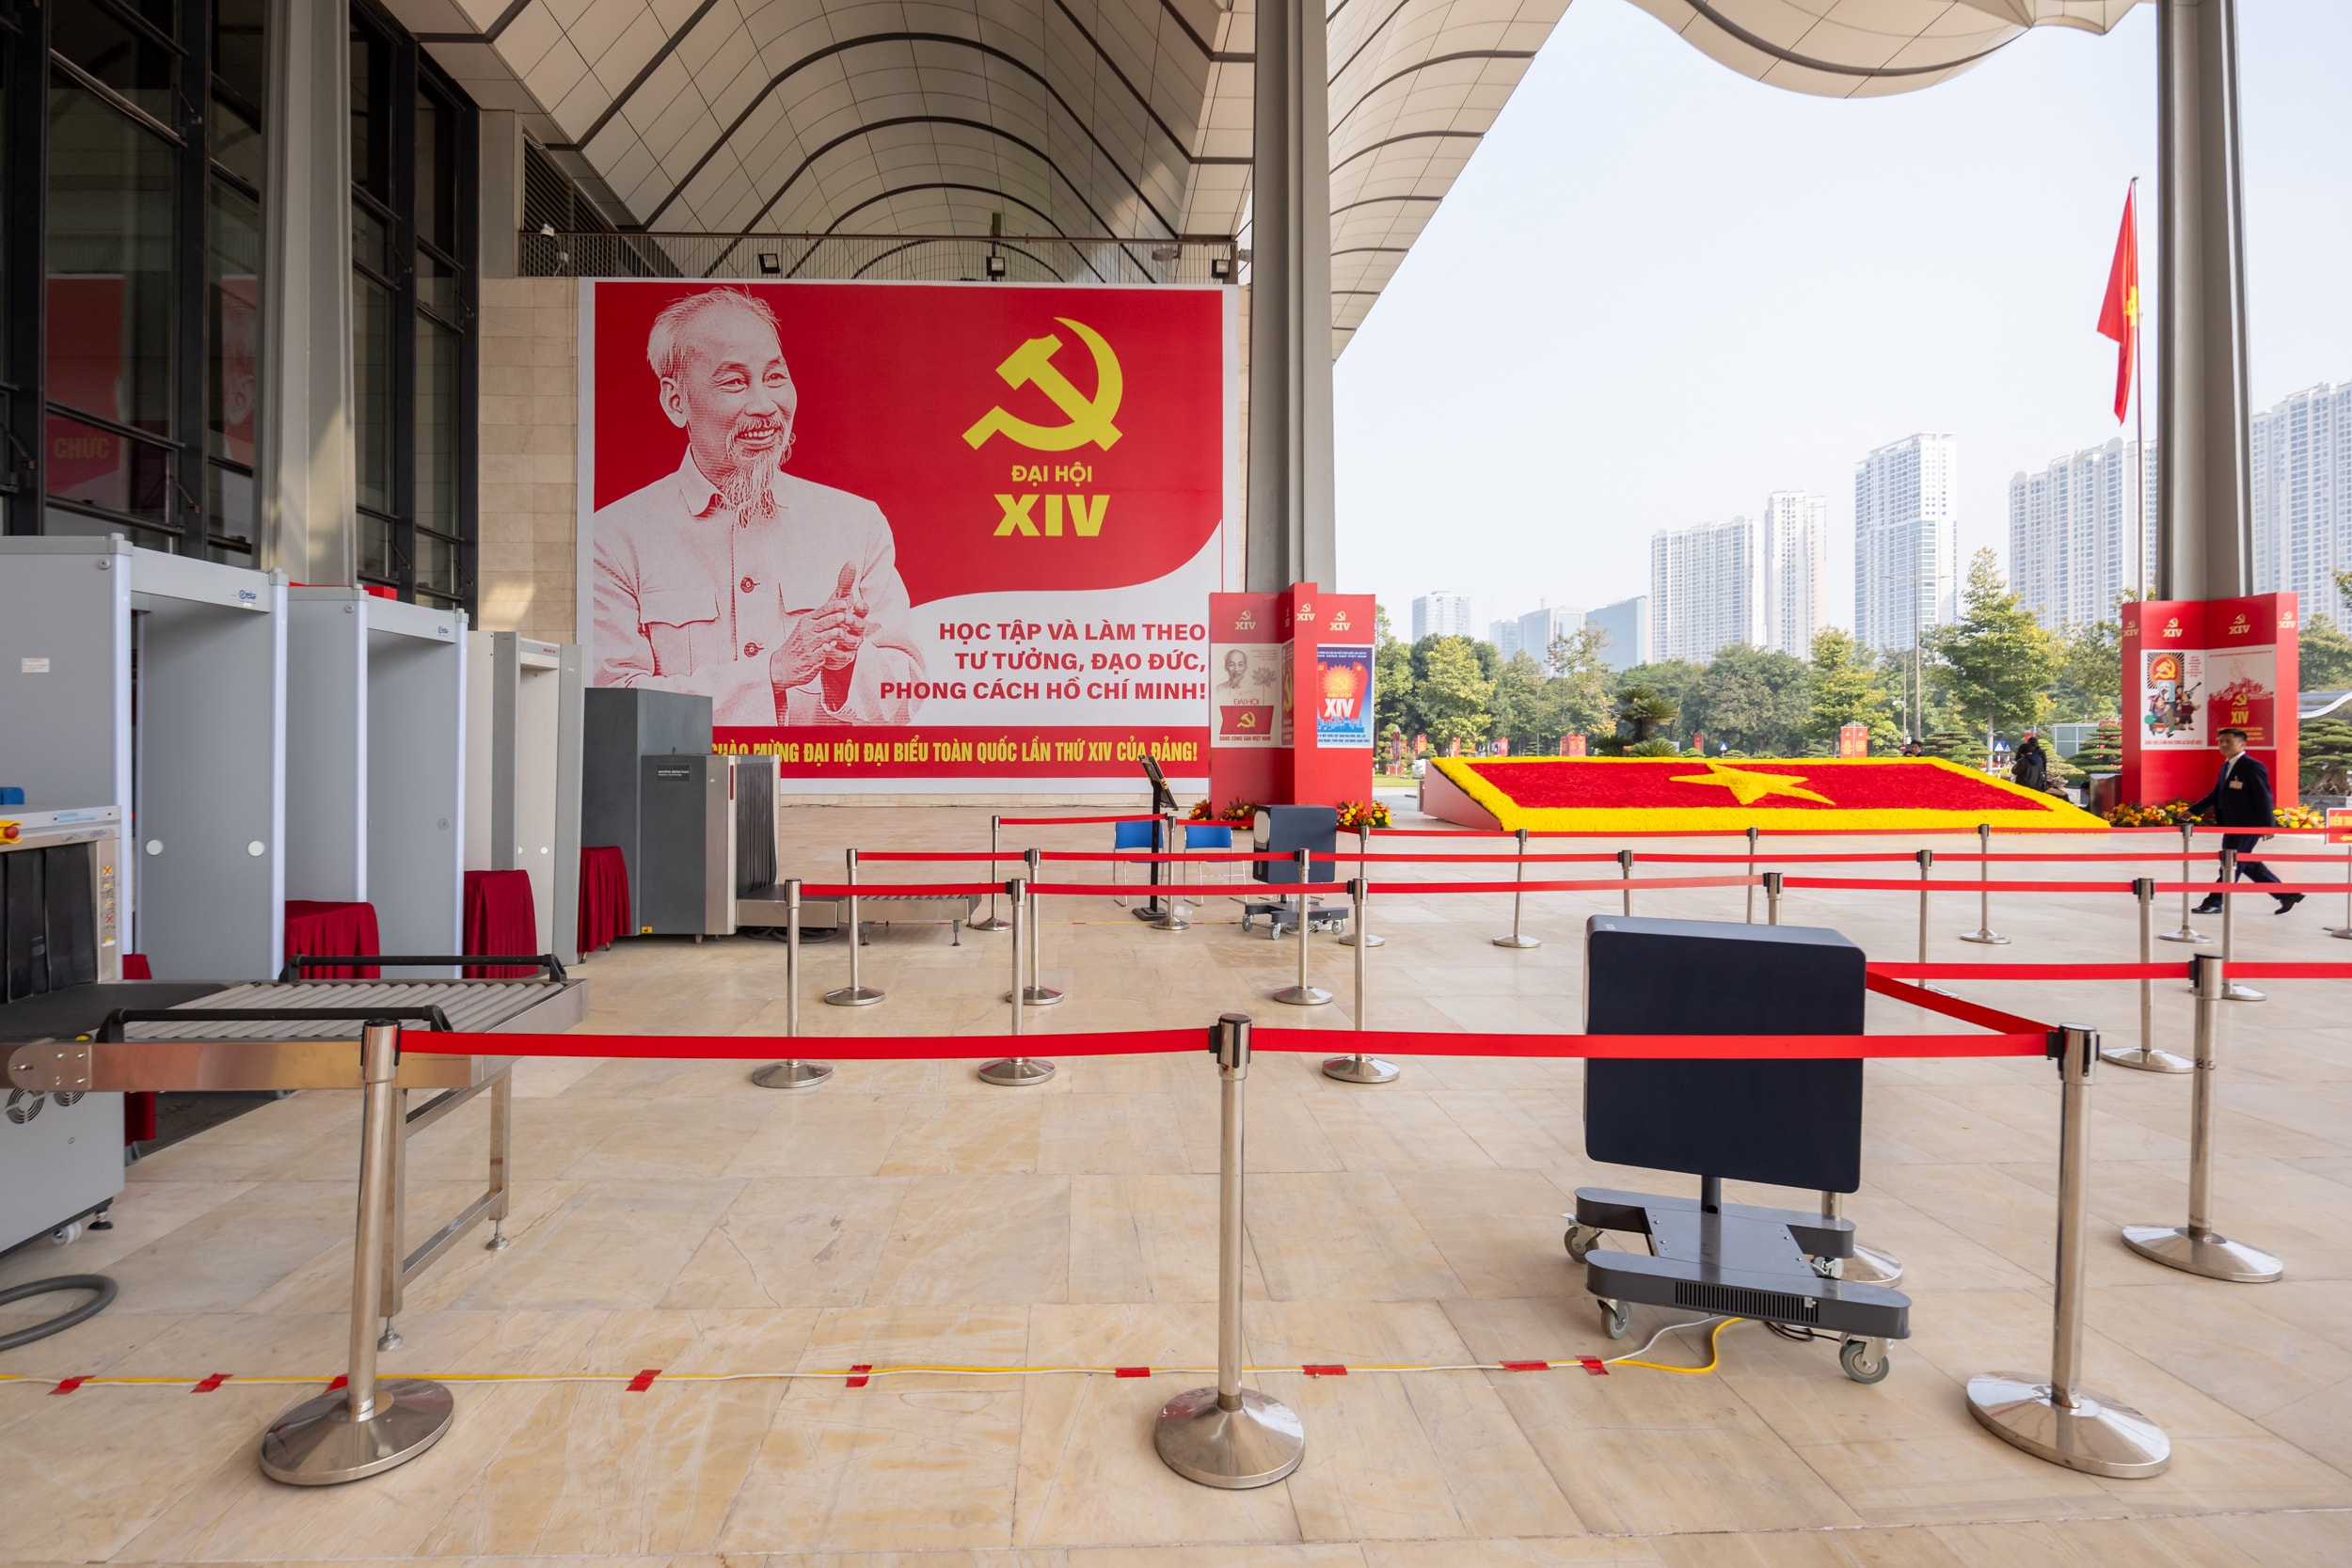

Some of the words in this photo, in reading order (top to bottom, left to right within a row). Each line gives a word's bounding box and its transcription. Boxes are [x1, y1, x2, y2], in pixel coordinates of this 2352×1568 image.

[1011, 465, 1048, 486] ĐẠI
[1055, 461, 1092, 487] HỘI
[993, 494, 1110, 537] XIV
[1235, 622, 1256, 630] XIV
[1296, 613, 1315, 622] XIV
[2278, 621, 2296, 629] XIV
[940, 623, 991, 645] HỌC
[997, 619, 1041, 645] TẬP
[1048, 619, 1078, 641] VÀ
[1085, 619, 1136, 641] LÀM
[1142, 624, 1206, 641] THEO
[1329, 623, 1351, 631] XIV
[2163, 627, 2183, 638] XIV
[2229, 625, 2250, 635] XIV
[955, 651, 989, 670] TƯ
[993, 647, 1085, 673] TƯỞNG,
[1091, 653, 1141, 674] ĐẠO
[1148, 649, 1206, 673] ĐỨC,
[880, 682, 966, 700] PHONG
[973, 678, 1040, 700] CÁCH
[1046, 676, 1081, 700] HỒ
[1087, 678, 1130, 700] CHÍ
[1135, 682, 1206, 700] MINH!
[1324, 698, 1355, 718] XIV
[2231, 710, 2249, 724] XIV
[803, 742, 830, 767] ĐẠI
[834, 738, 860, 767] HỘI
[864, 742, 890, 767] ĐẠI
[894, 735, 929, 762] BIỂU
[932, 738, 973, 762] TOÀN
[977, 736, 1018, 764] QUỐC
[1022, 736, 1051, 762] LẦN
[1055, 738, 1086, 762] THỨ
[1089, 741, 1113, 762] XIV
[1117, 736, 1146, 762] CỦA
[1151, 736, 1198, 763] ĐẢNG!
